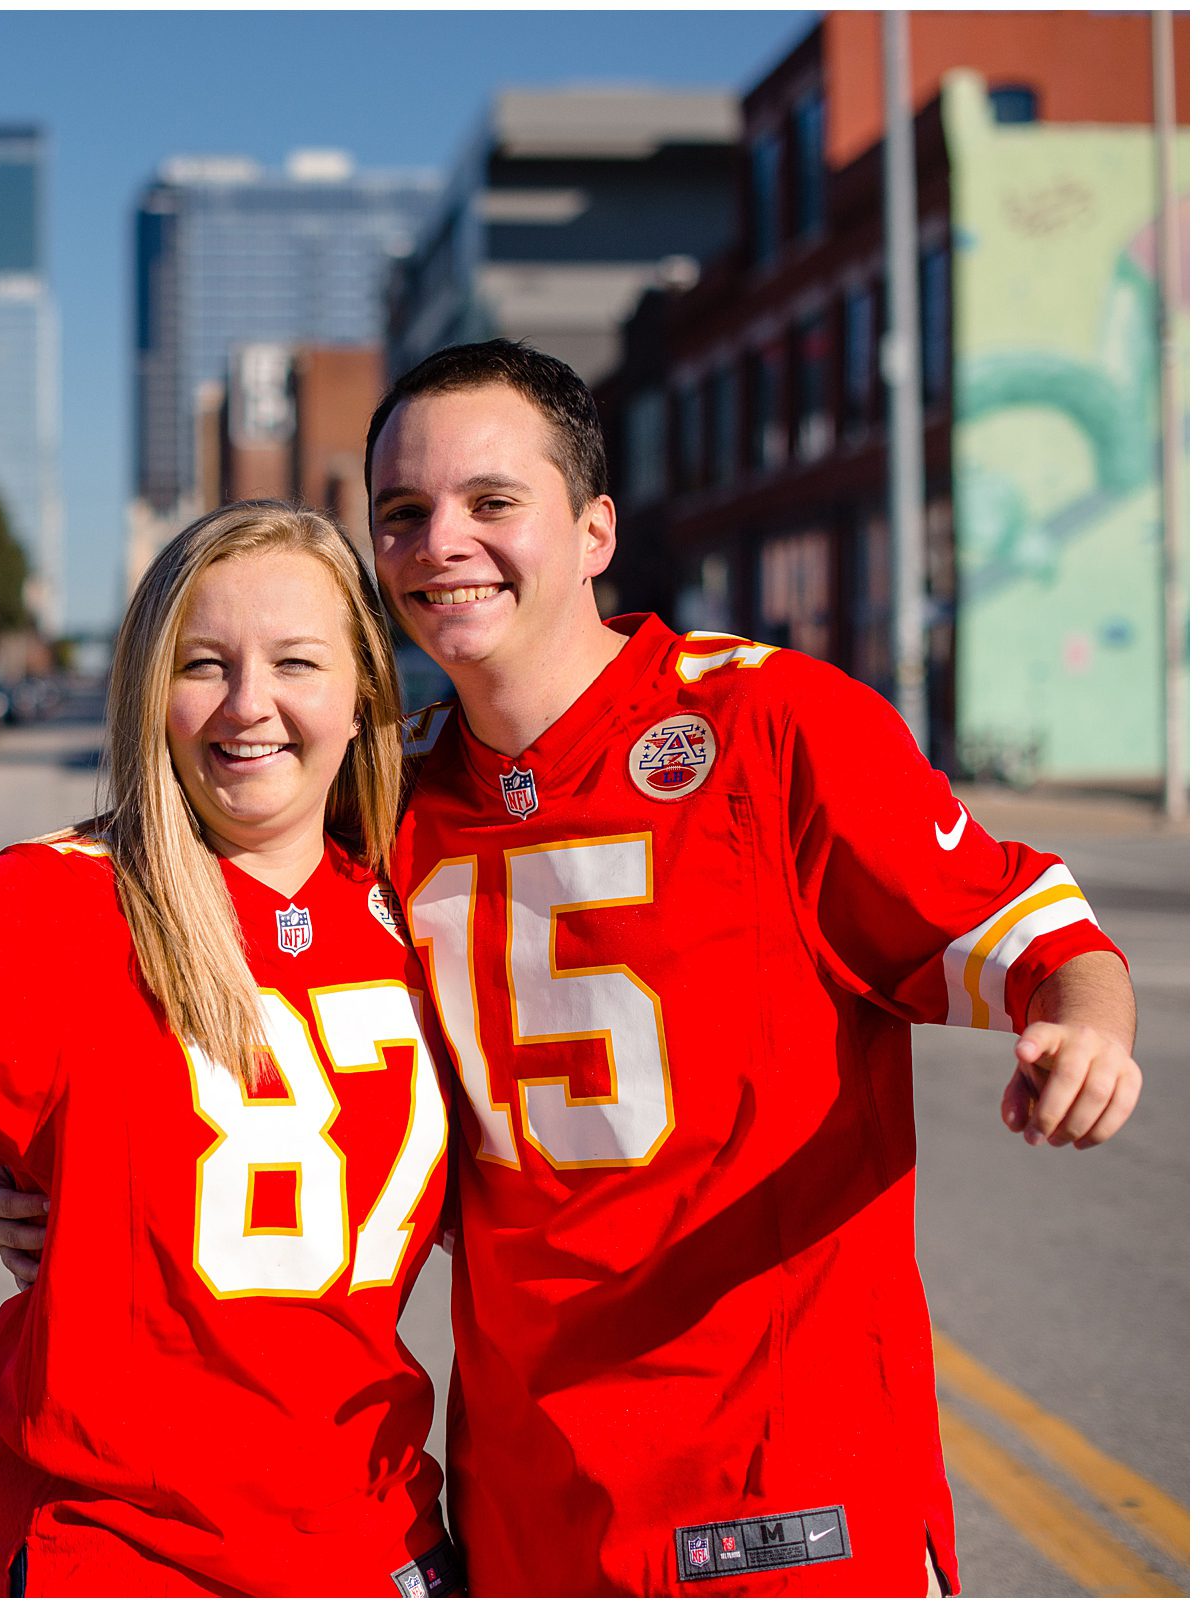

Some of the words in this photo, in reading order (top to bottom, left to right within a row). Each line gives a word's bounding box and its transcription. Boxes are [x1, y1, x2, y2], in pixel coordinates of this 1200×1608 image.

[638, 723, 707, 770] A
[662, 771, 684, 784] LH
[506, 789, 534, 811] NFL
[283, 926, 308, 948] NFL
[407, 831, 676, 1172] 15
[172, 979, 449, 1300] 87
[760, 1522, 786, 1545] M
[691, 1549, 709, 1563] NFL
